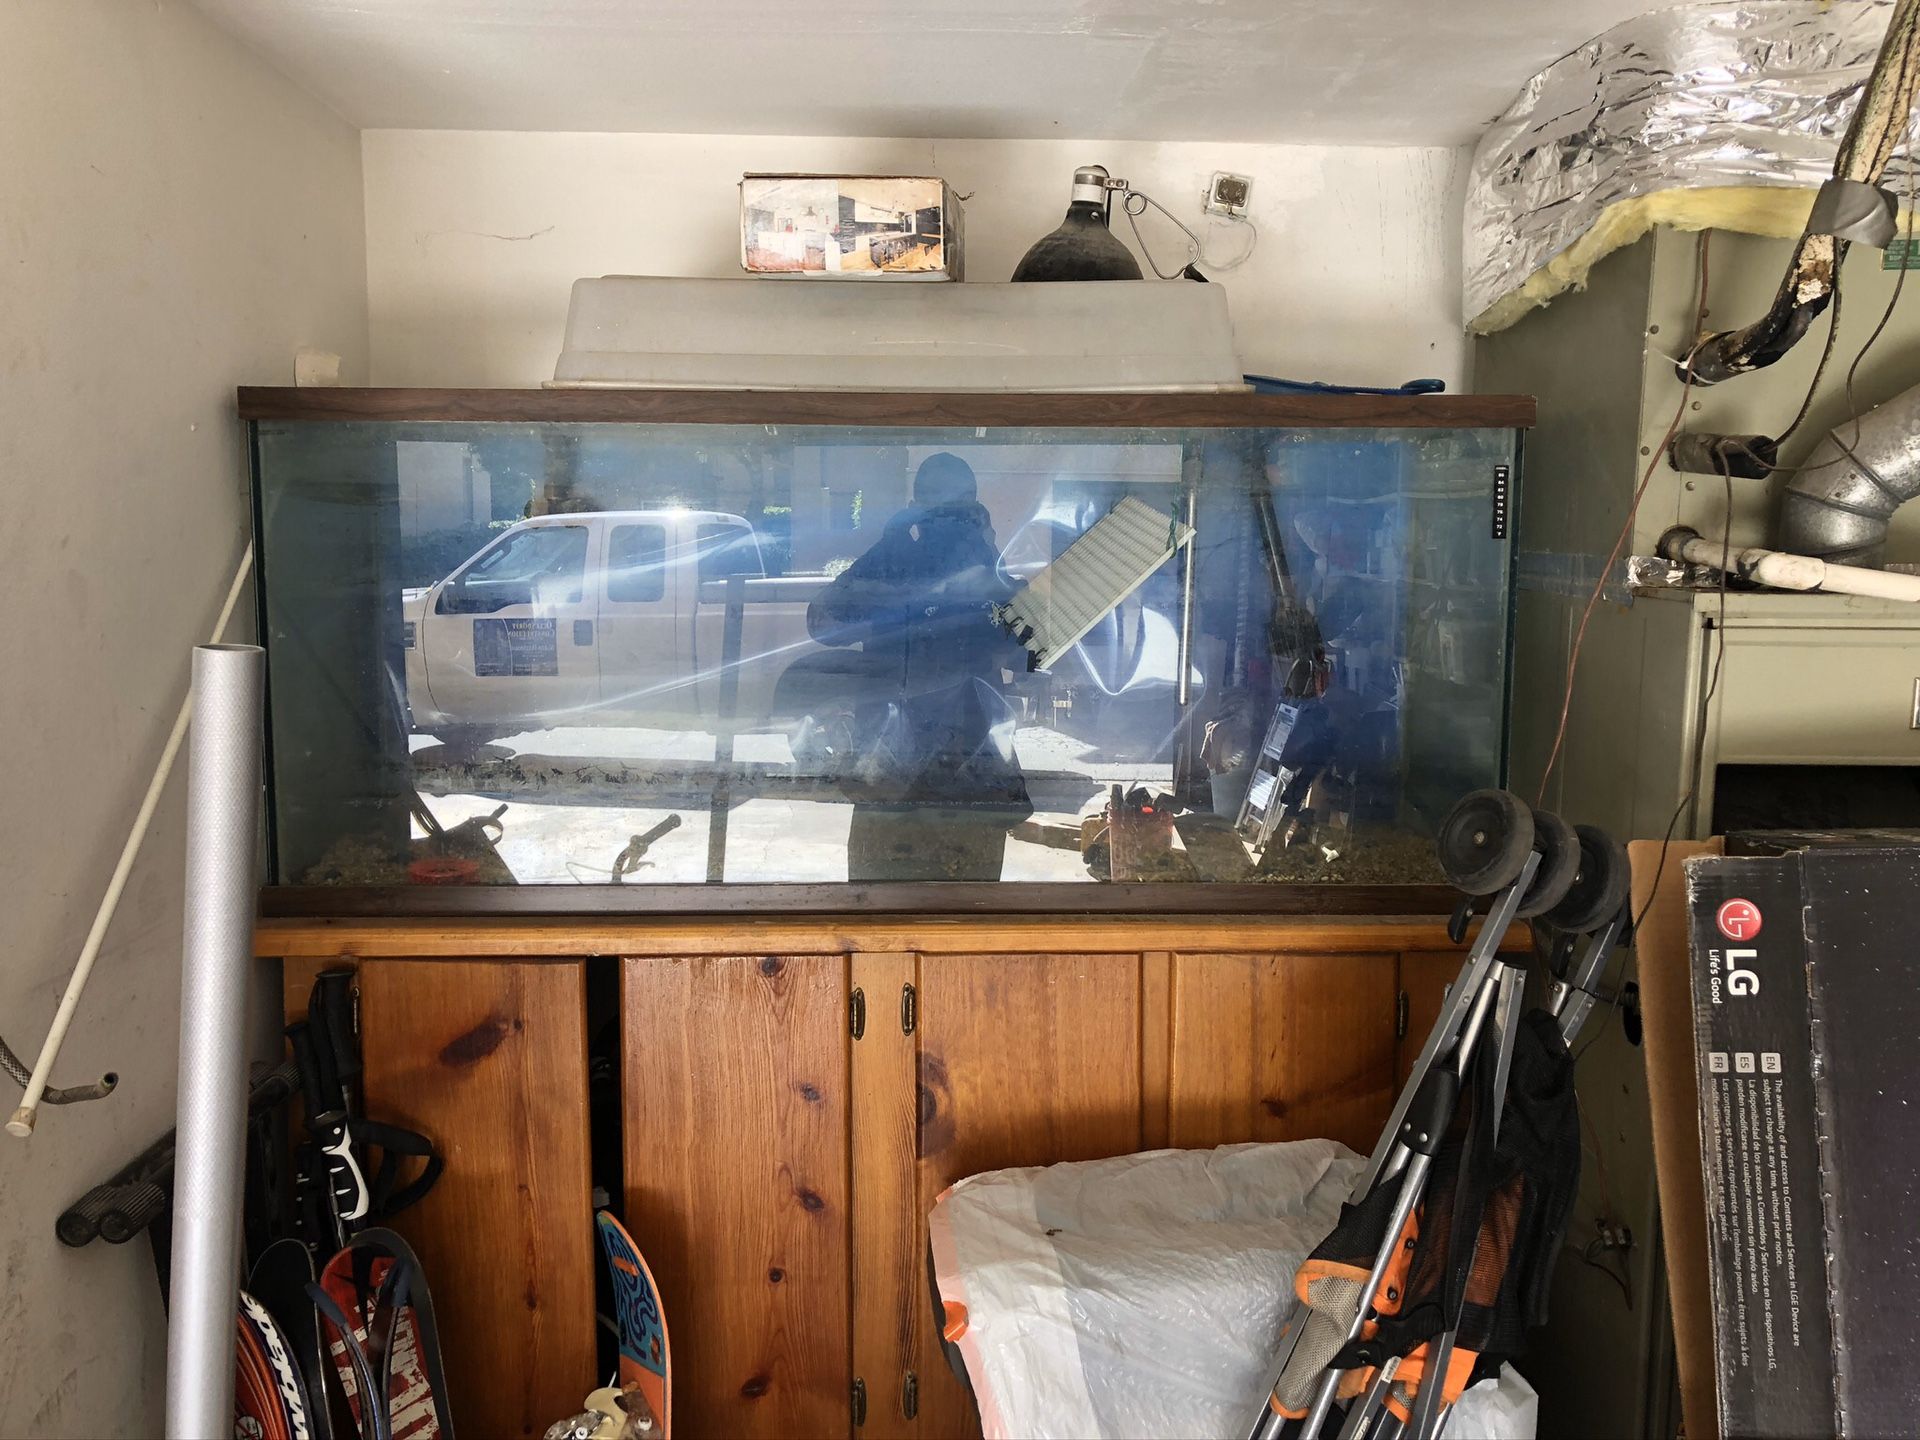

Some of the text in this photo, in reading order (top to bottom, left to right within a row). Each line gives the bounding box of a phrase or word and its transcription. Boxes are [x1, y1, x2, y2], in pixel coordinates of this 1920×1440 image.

[1709, 949, 1723, 1004] Life's Good
[1726, 949, 1760, 996] LG
[1714, 1057, 1722, 1068] FR
[1740, 1057, 1749, 1068] ES
[1766, 1057, 1775, 1070] EN
[1736, 1079, 1745, 1106] pueden
[1749, 1080, 1756, 1088] La
[1762, 1079, 1772, 1105] subject
[1748, 1090, 1760, 1140] disponibilidad
[1776, 1095, 1785, 1133] availability
[1740, 1108, 1748, 1150] modificarse
[1766, 1118, 1774, 1143] change
[1779, 1135, 1787, 1144] of
[1743, 1152, 1749, 1161] en
[1753, 1142, 1760, 1150] de
[1743, 1163, 1751, 1196] cualquier
[1772, 1191, 1780, 1219] without
[1784, 1196, 1792, 1231] Contents
[1758, 1202, 1766, 1244] Contenidos
[1772, 1222, 1781, 1239] prior
[1747, 1248, 1757, 1271] previo
[1761, 1253, 1770, 1286] Servicios
[1734, 1272, 1745, 1302] peuvent
[1764, 1288, 1769, 1297] en
[1738, 1322, 1748, 1345] sujets
[1764, 1312, 1775, 1357] dispositivos
